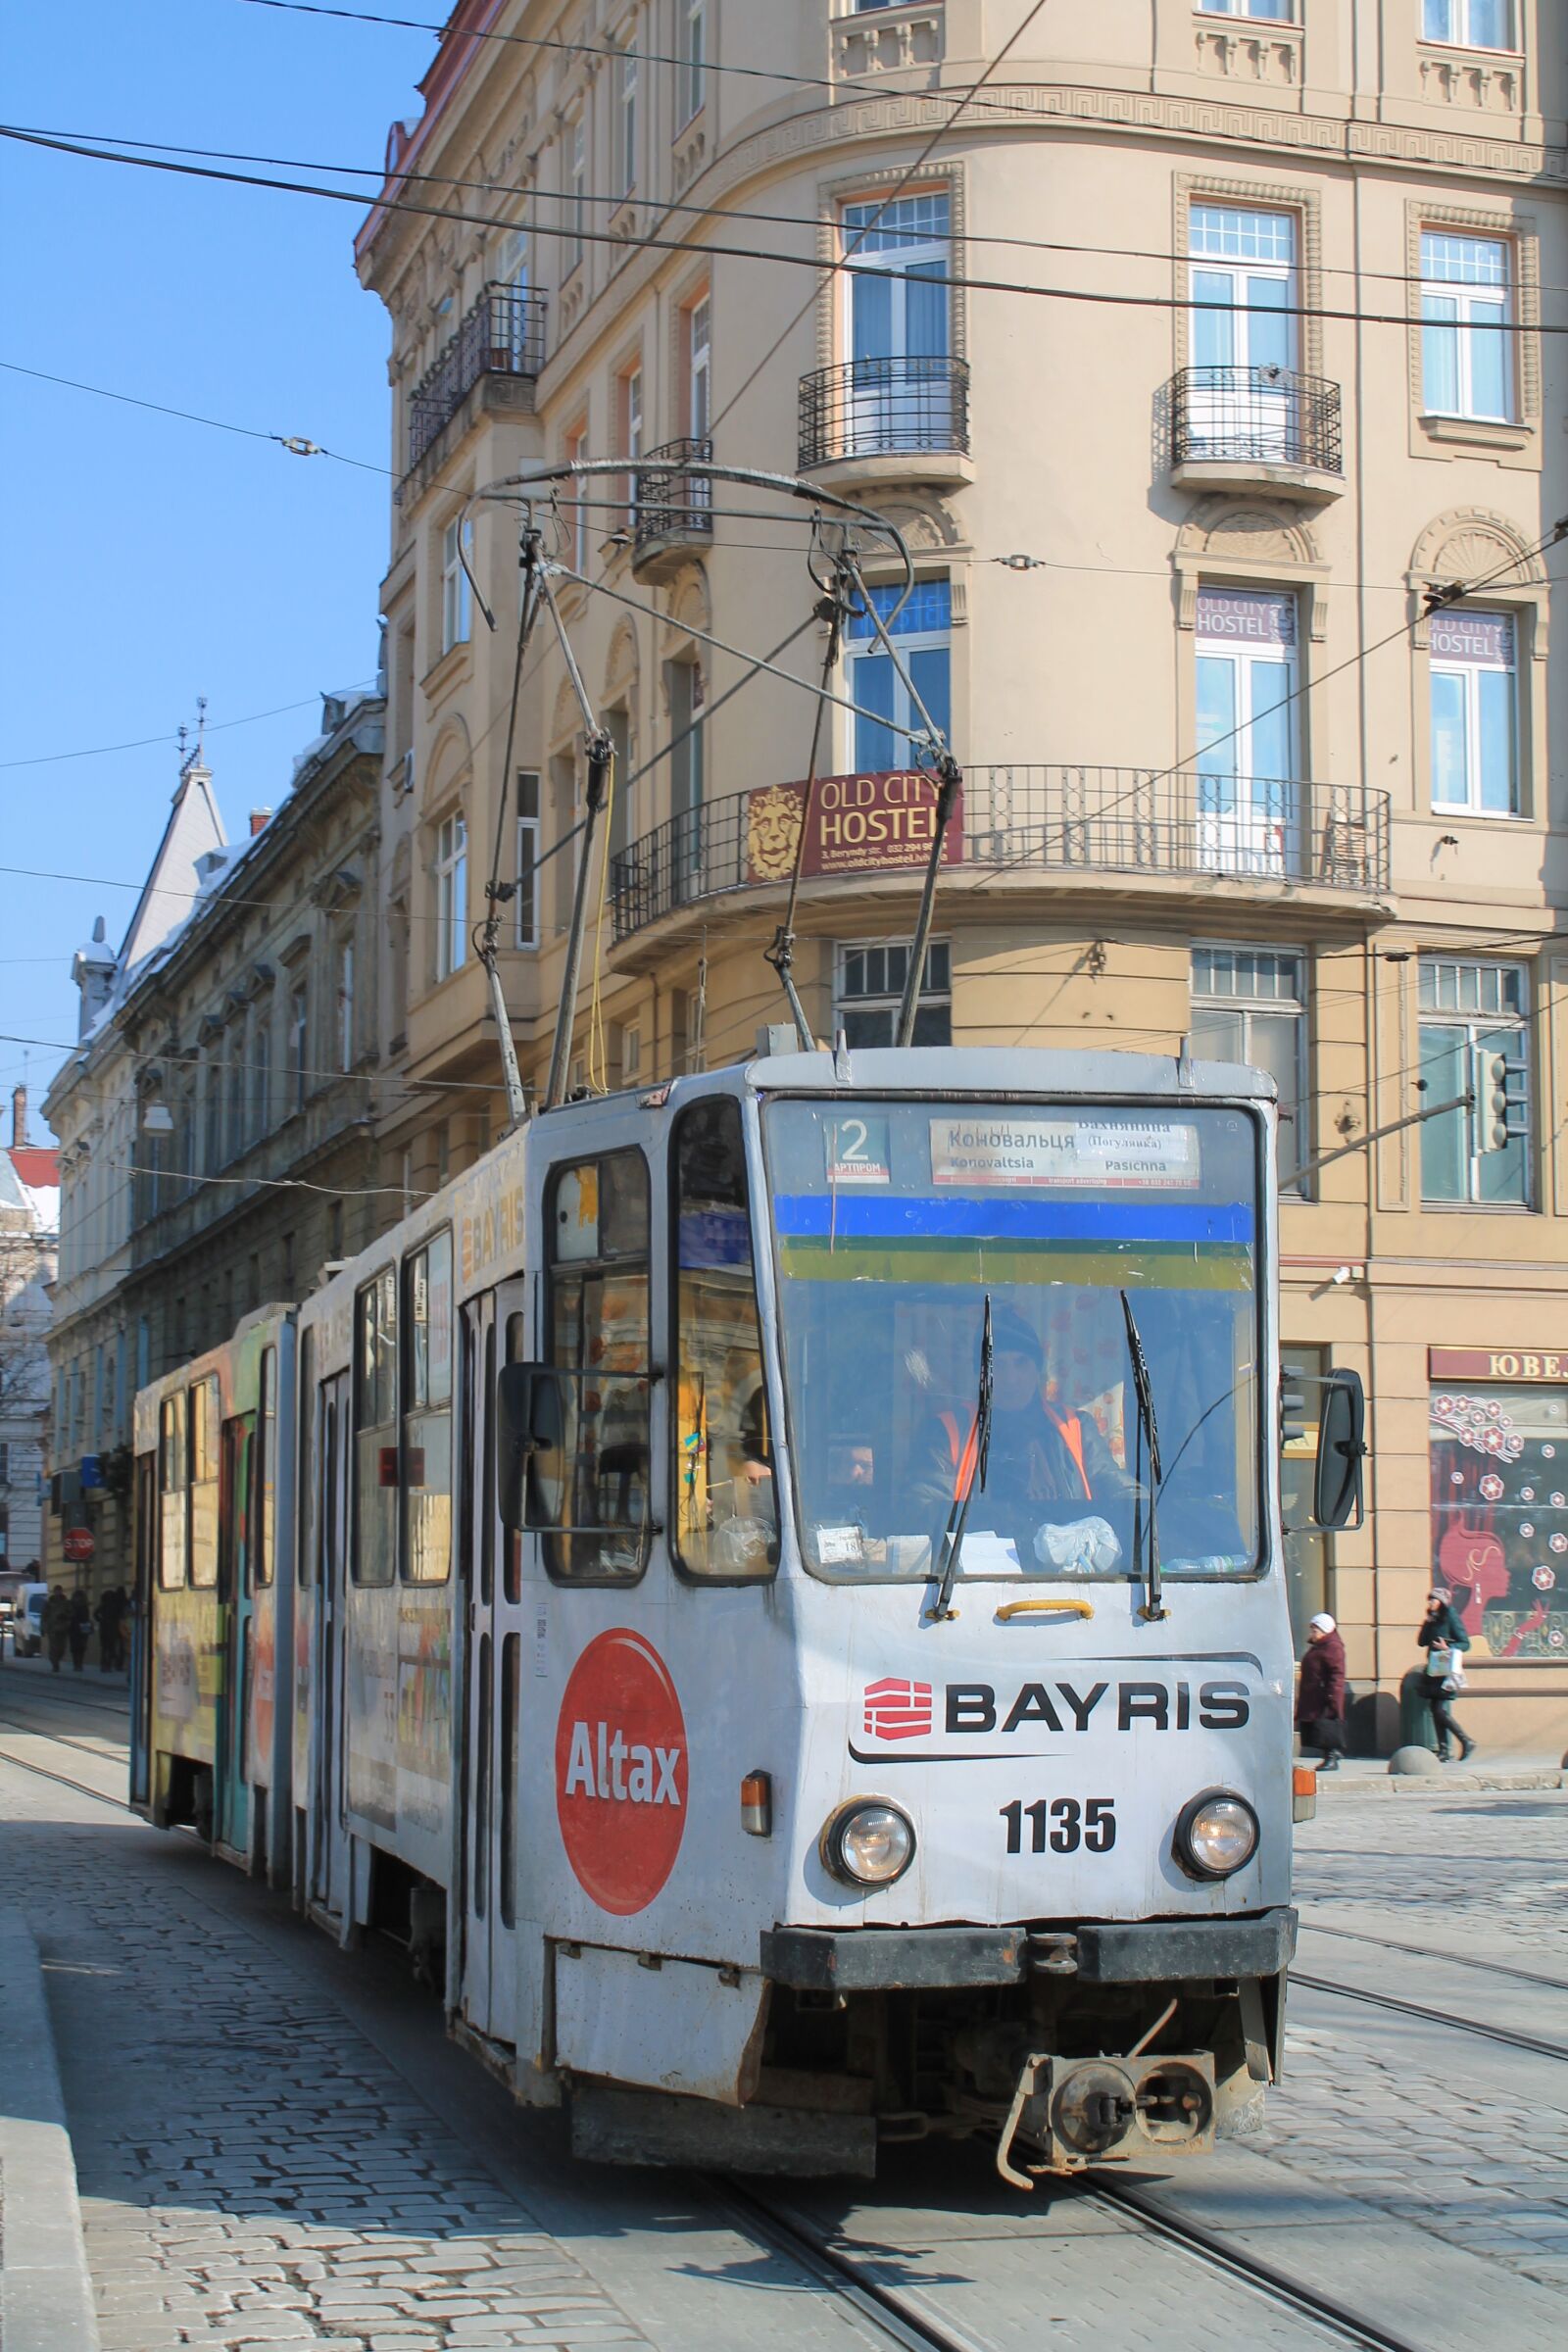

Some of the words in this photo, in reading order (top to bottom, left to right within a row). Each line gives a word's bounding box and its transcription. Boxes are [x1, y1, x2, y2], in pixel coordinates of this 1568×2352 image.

[1198, 597, 1230, 612] OLD
[1233, 599, 1267, 615] CITY
[1198, 613, 1269, 635] HOSTEL
[1459, 618, 1492, 635] CITY
[820, 779, 876, 809] OLD
[883, 775, 942, 805] CITY
[820, 806, 948, 847] HOSTEL
[841, 1119, 868, 1160] 2
[950, 1130, 1075, 1152] Коновальця
[1088, 1135, 1161, 1150] (Погулянка)
[834, 1162, 880, 1173] АРТПРОМ
[951, 1156, 1034, 1169] Konovaltsia
[1104, 1160, 1166, 1172] Pasichna
[1489, 1354, 1568, 1379] ЮВЕ
[945, 1681, 1250, 1734] BAYRIS
[564, 1721, 682, 1806] Altax
[999, 1797, 1116, 1854] 1135
